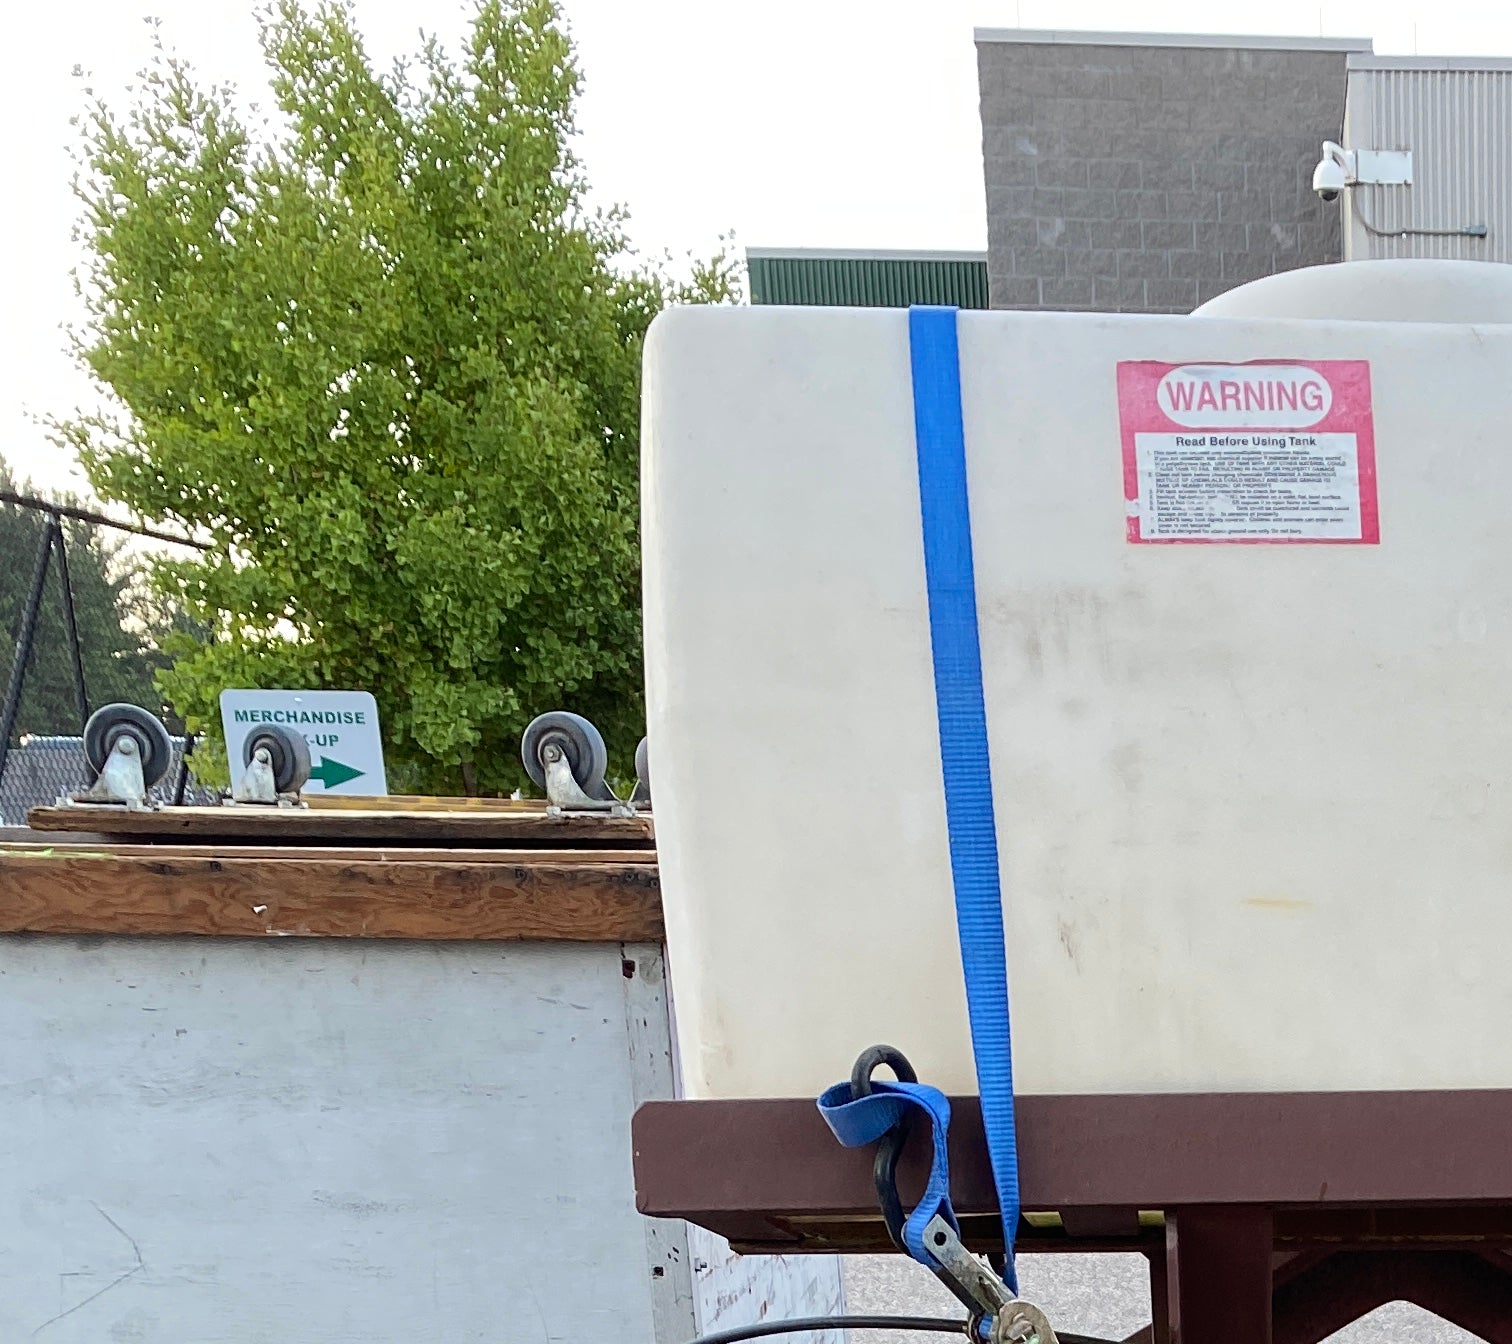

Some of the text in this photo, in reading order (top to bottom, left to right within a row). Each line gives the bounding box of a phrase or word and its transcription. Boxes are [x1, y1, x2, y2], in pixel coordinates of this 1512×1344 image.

[1165, 380, 1324, 411] WARNING
[1175, 436, 1316, 449] Read Before Using Tank
[234, 709, 366, 725] MERCHANDISE
